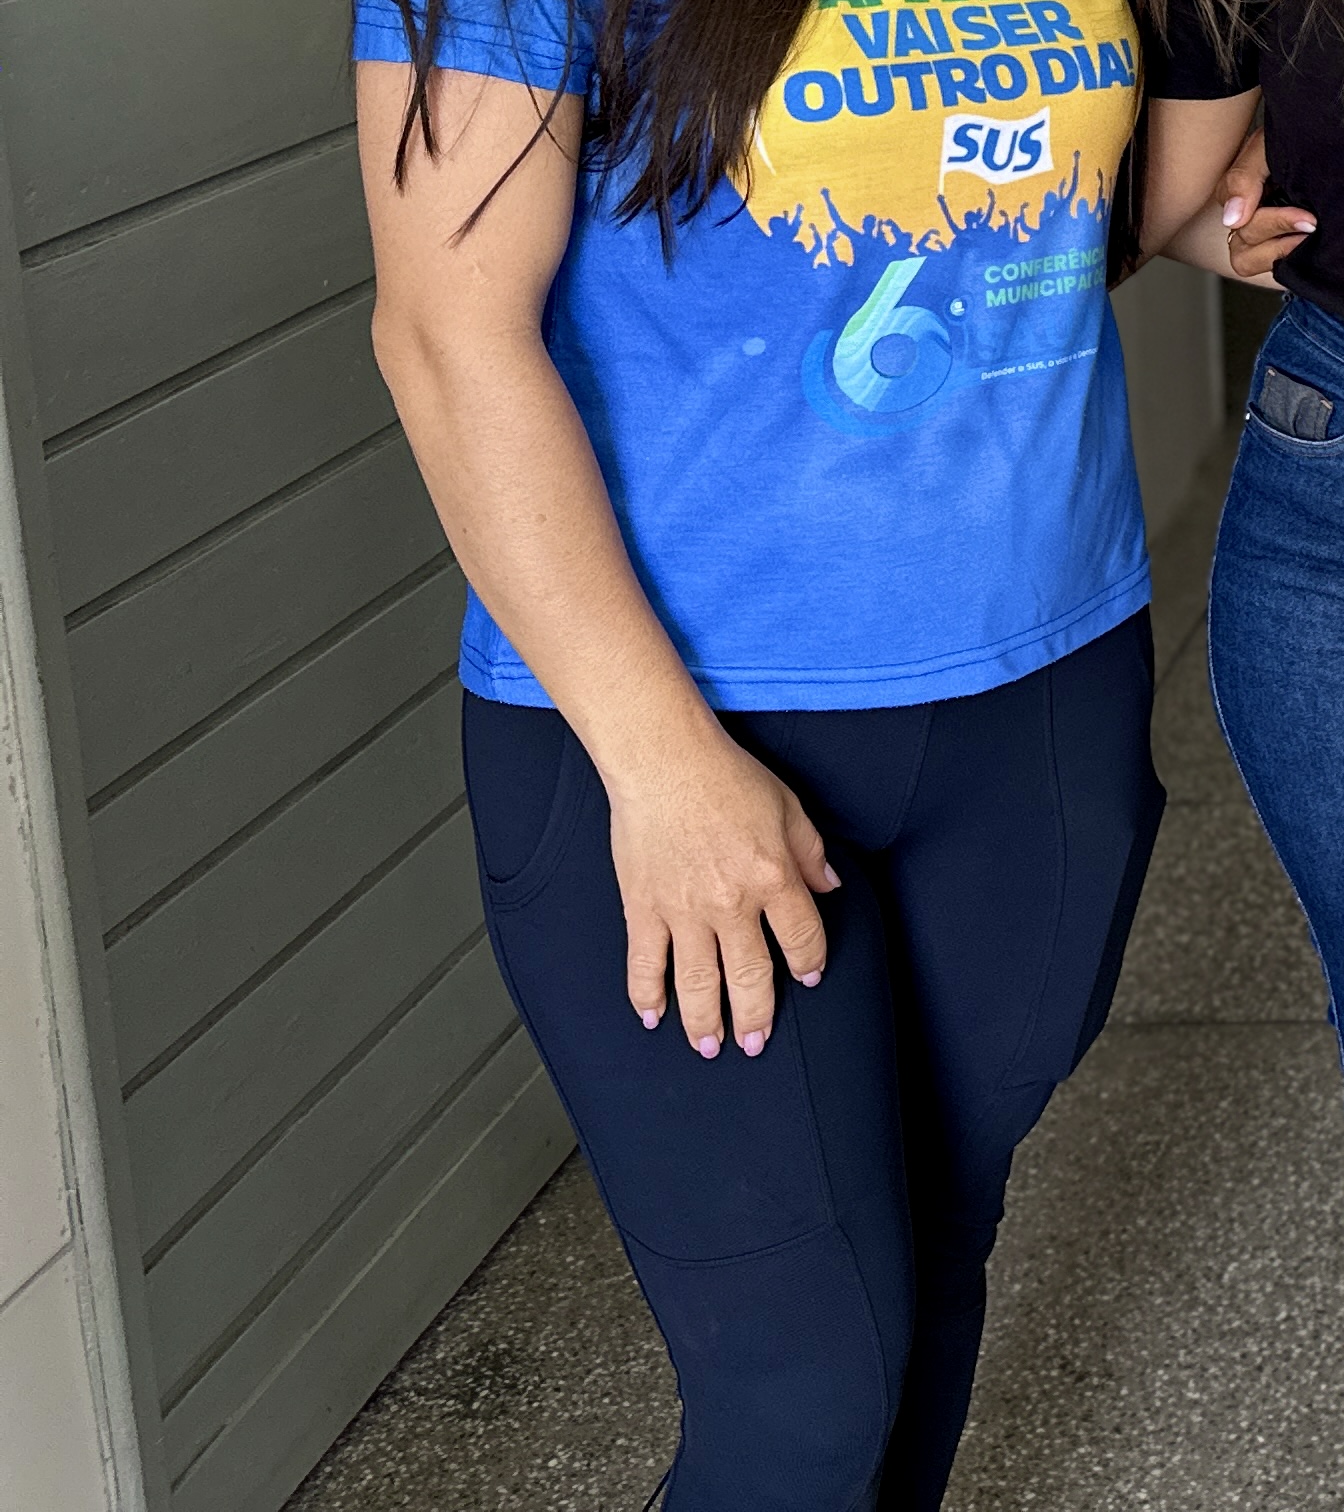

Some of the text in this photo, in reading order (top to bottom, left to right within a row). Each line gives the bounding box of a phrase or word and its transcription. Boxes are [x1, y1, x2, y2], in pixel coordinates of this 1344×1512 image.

[842, 0, 1085, 59] VAI SER
[783, 39, 1135, 123] OUTRO DIA!
[947, 120, 1046, 172] SUS
